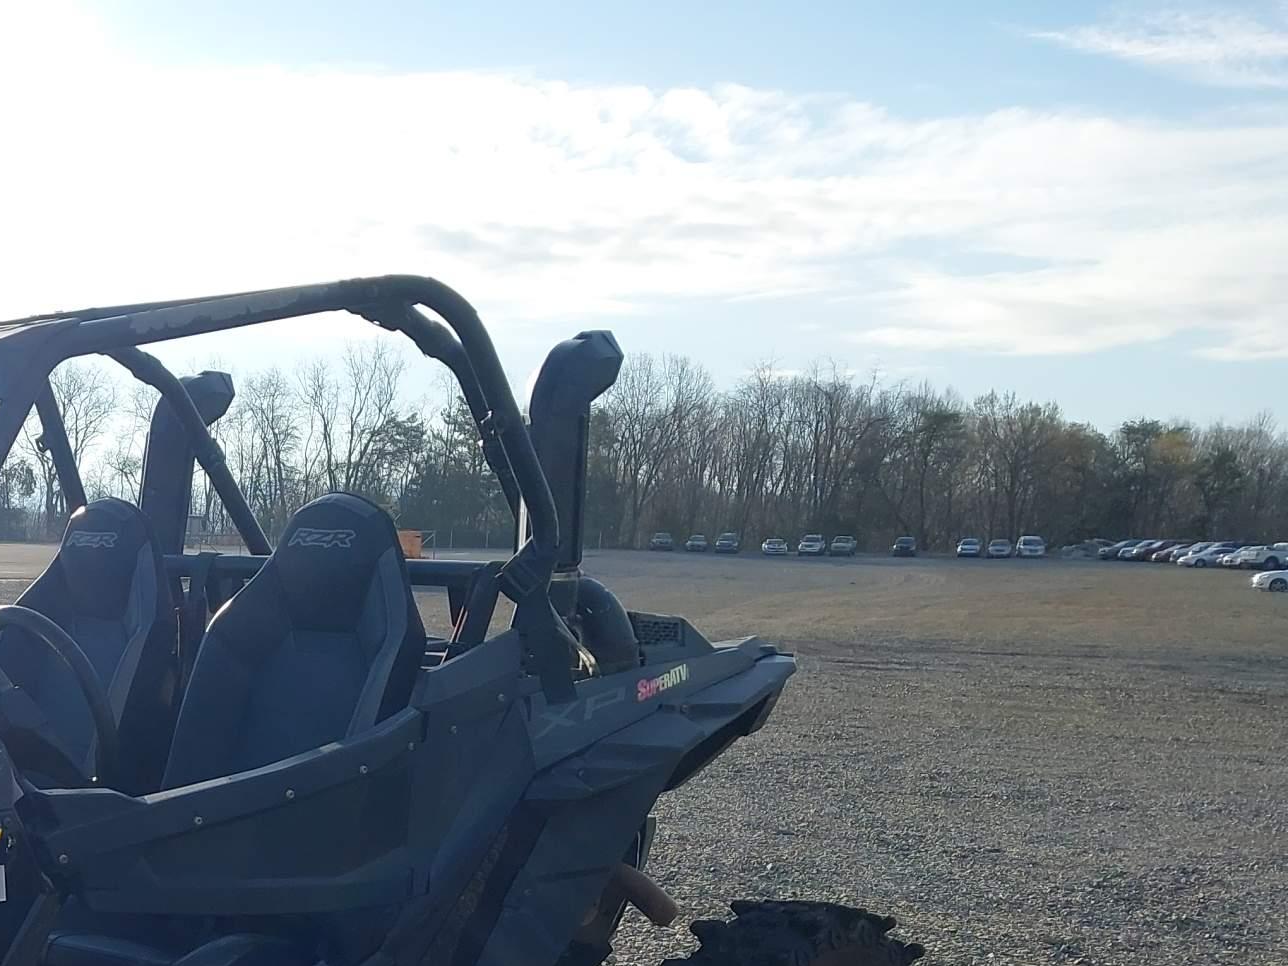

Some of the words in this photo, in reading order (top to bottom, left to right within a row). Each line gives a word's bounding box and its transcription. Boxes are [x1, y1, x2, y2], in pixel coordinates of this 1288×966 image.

[66, 531, 118, 548] RZR
[288, 528, 357, 548] RZR
[535, 687, 626, 738] XP
